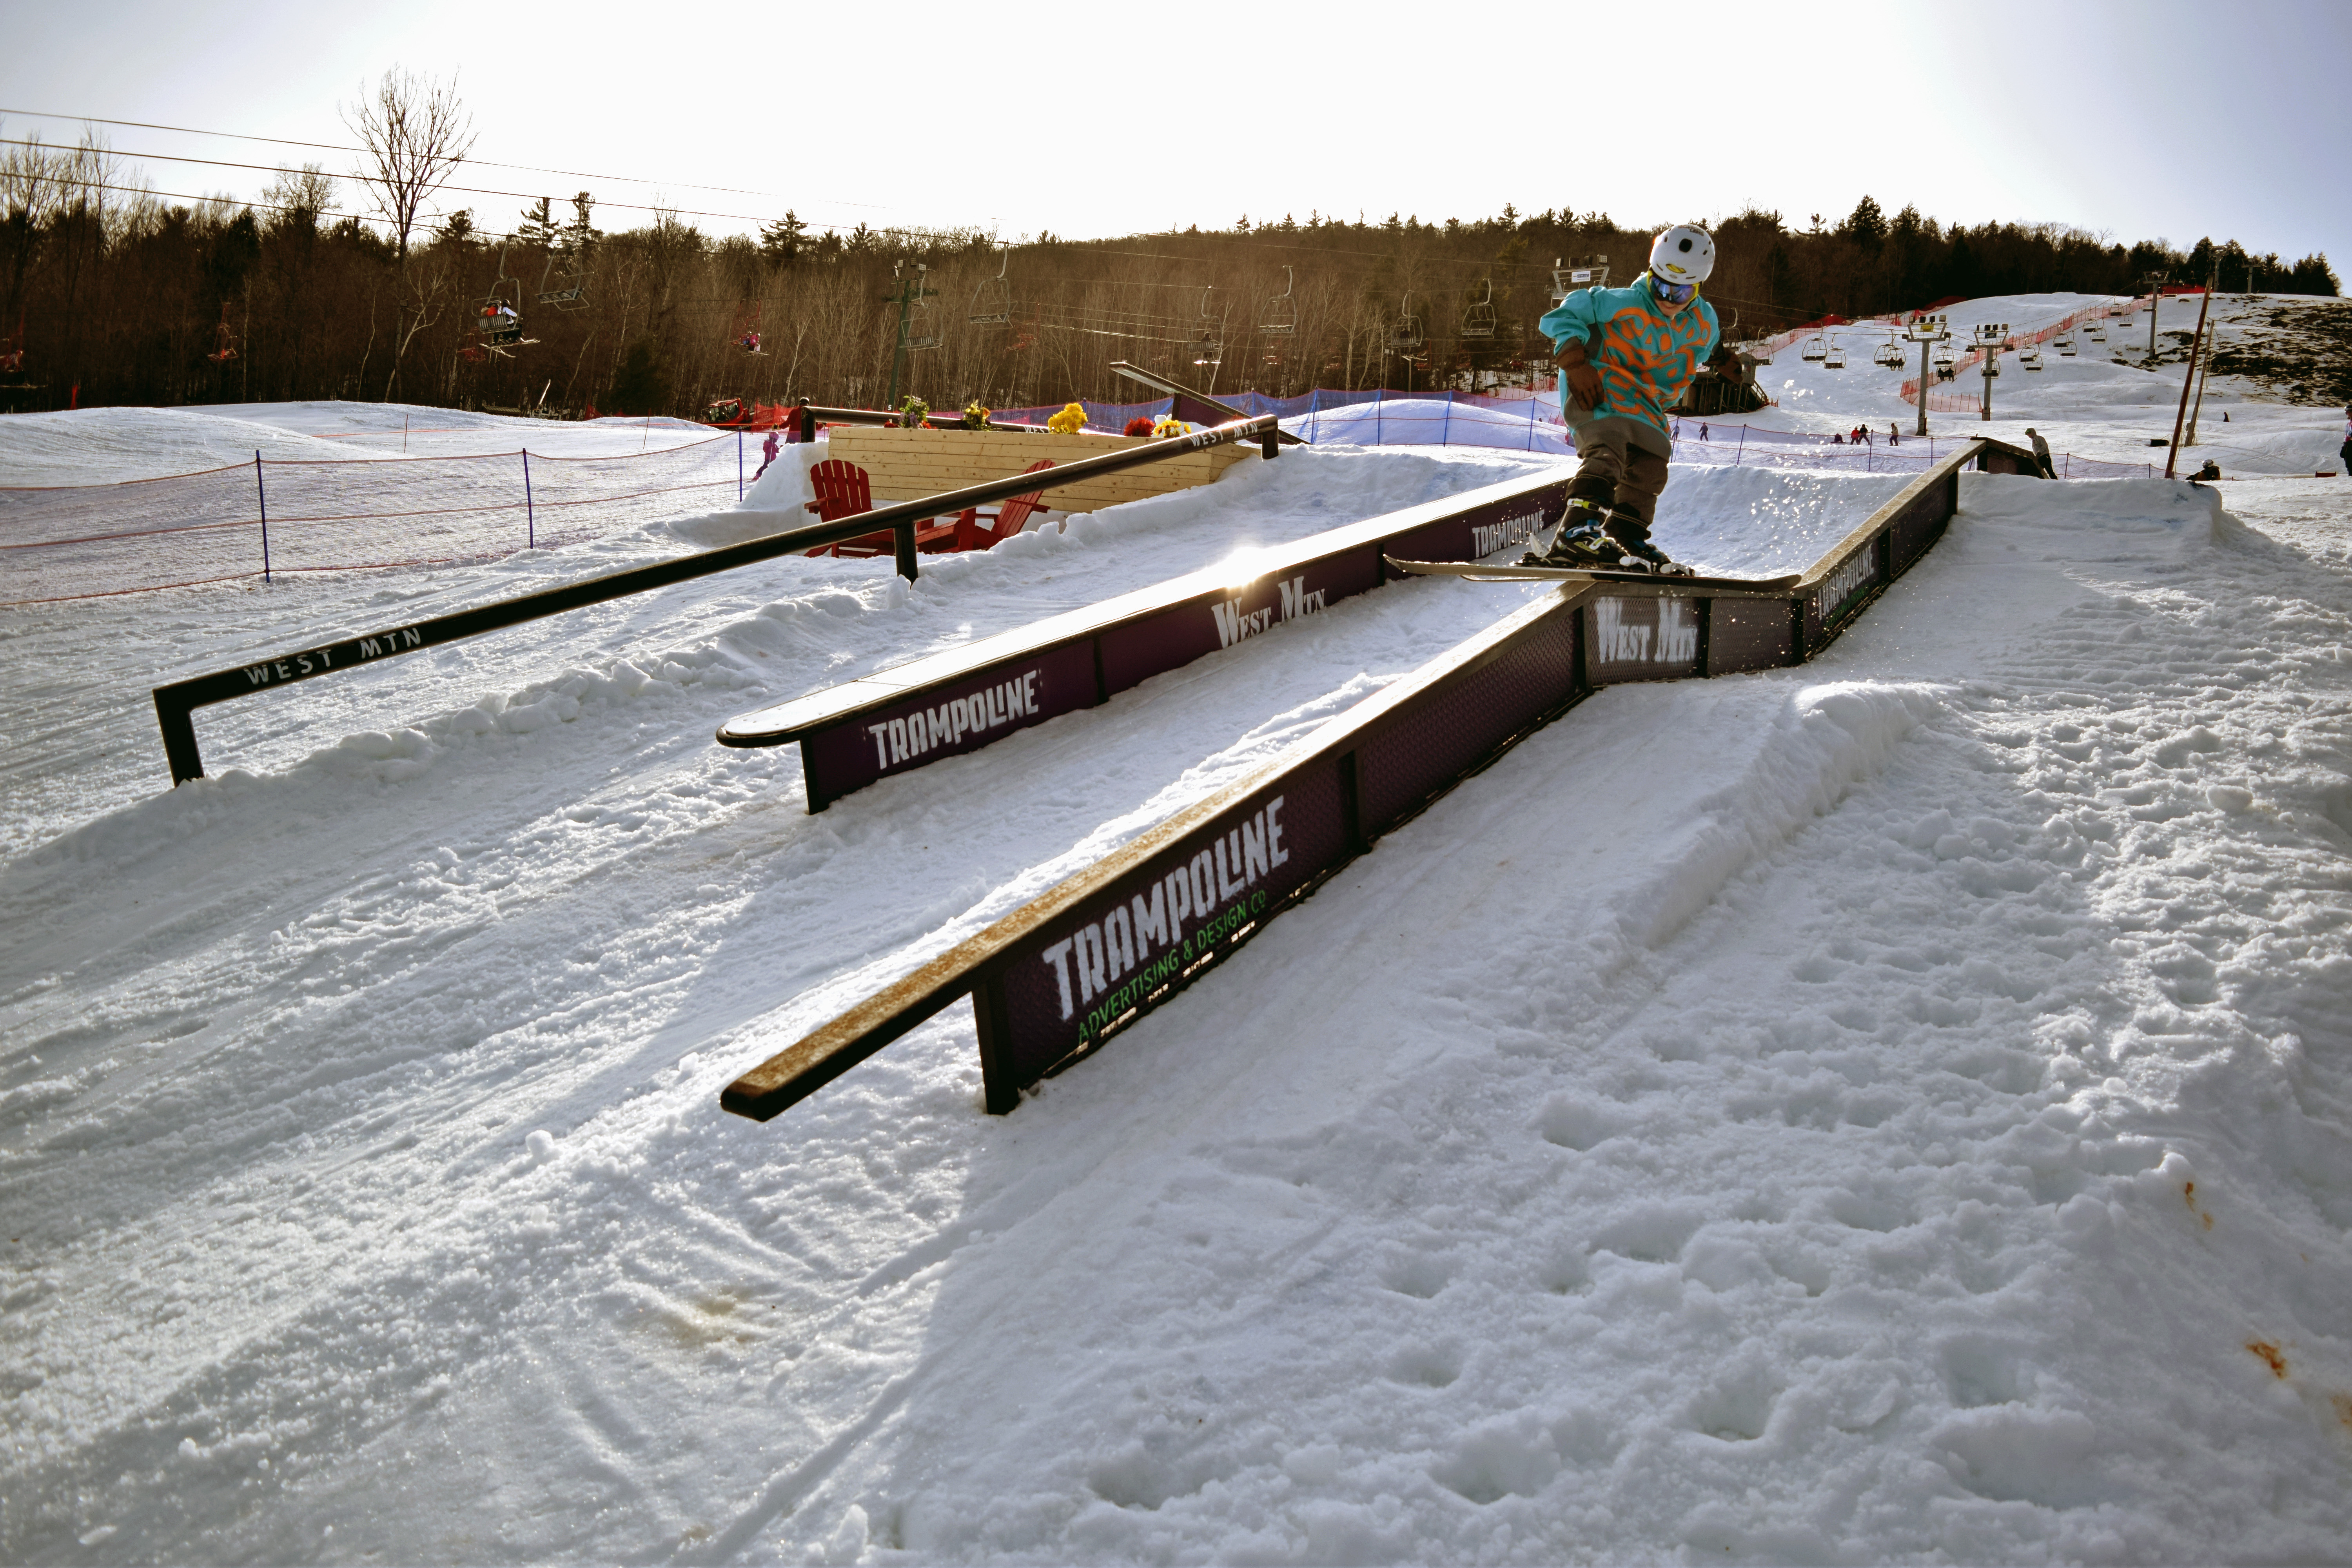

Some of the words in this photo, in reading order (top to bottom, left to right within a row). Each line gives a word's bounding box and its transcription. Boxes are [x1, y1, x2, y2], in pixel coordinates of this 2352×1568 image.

[1189, 430, 1223, 446] WEST
[1234, 422, 1258, 438] MTN
[1472, 509, 1544, 558] TRAMPOLINE
[243, 649, 331, 685] WEST
[359, 628, 421, 659] MTN
[868, 670, 1039, 769] TRAMPOLINE
[1042, 795, 1289, 1022] TRAMPOLINE
[1079, 949, 1179, 1045] ADVERTISING
[1183, 940, 1193, 961] &
[1196, 900, 1247, 952] DESIGN
